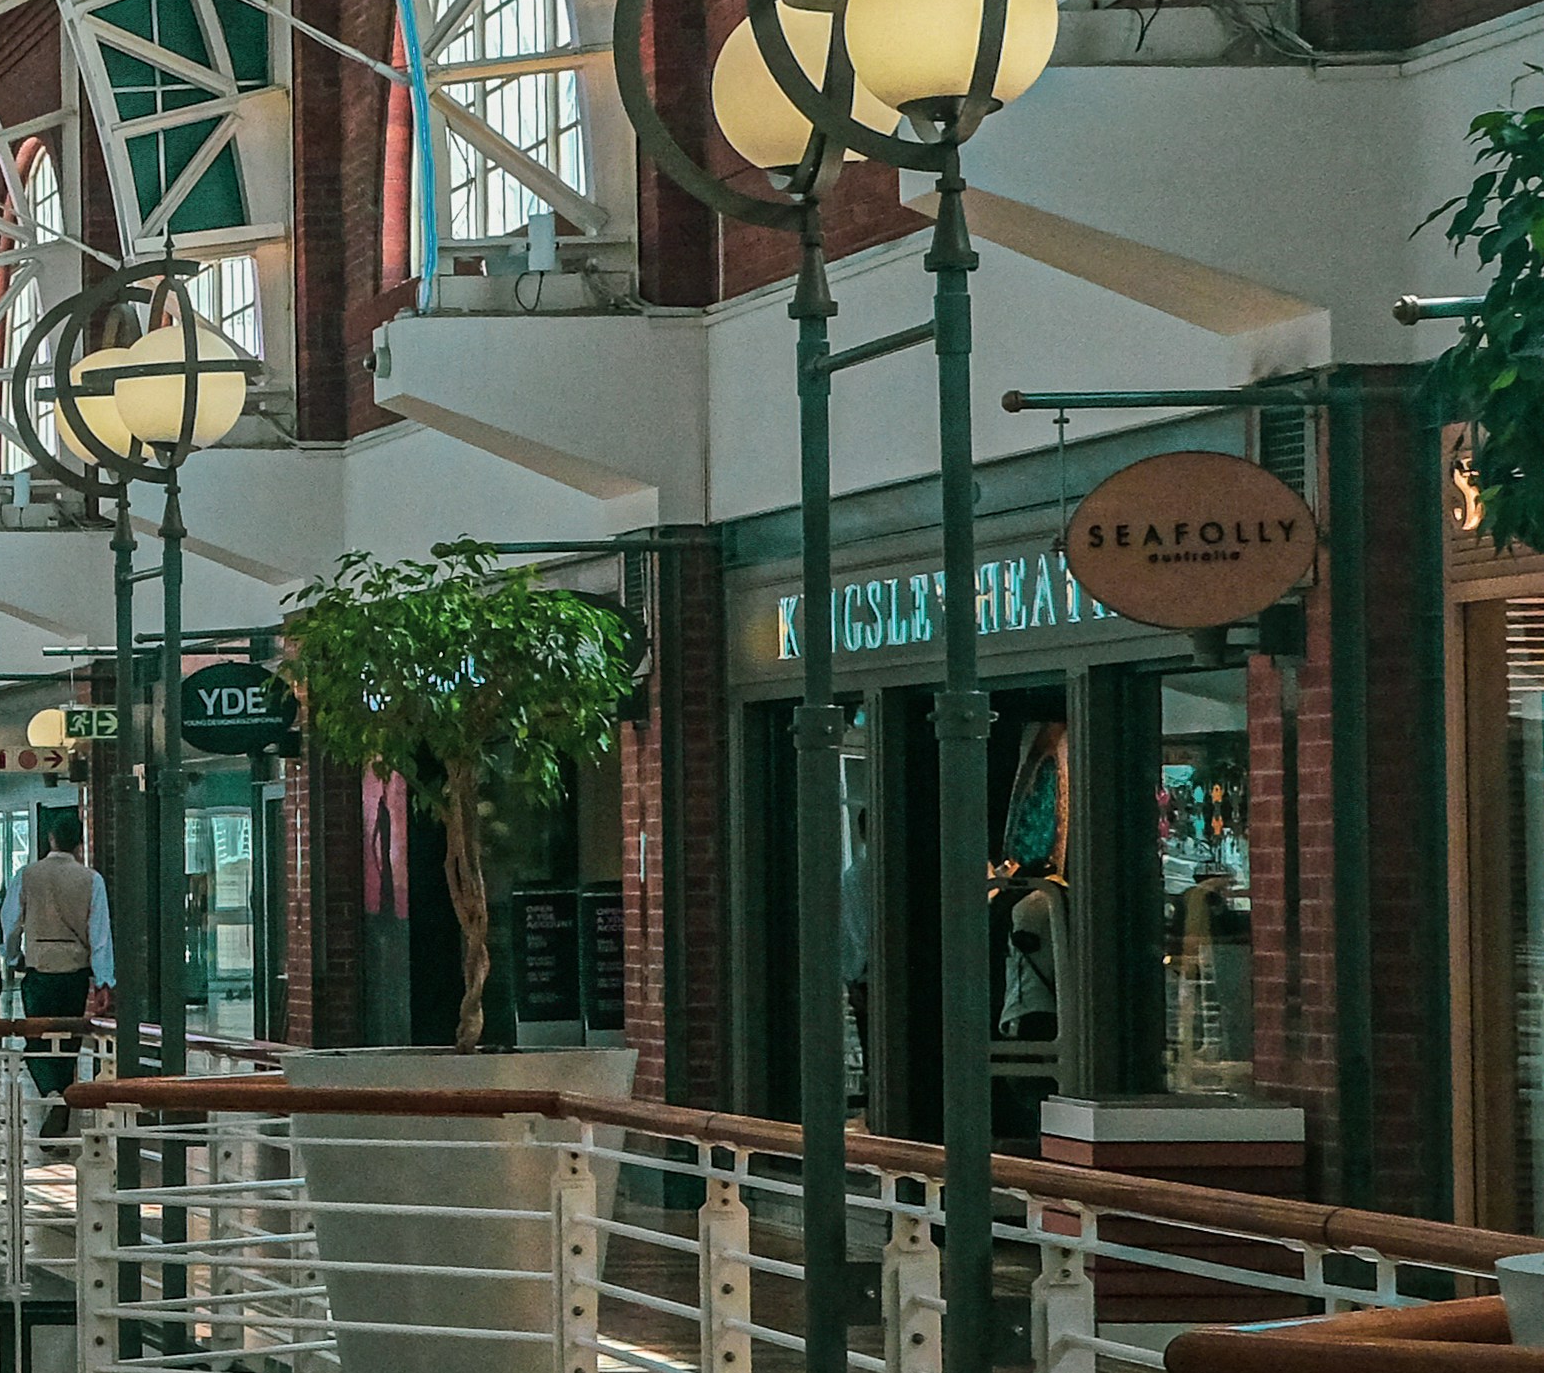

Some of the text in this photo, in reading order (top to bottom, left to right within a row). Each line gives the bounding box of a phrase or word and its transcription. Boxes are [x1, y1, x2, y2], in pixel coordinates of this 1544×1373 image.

[1088, 519, 1296, 548] SEAFOLLY
[1148, 550, 1241, 563] australia
[975, 553, 1118, 635] HEAT
[198, 687, 267, 716] YDE
